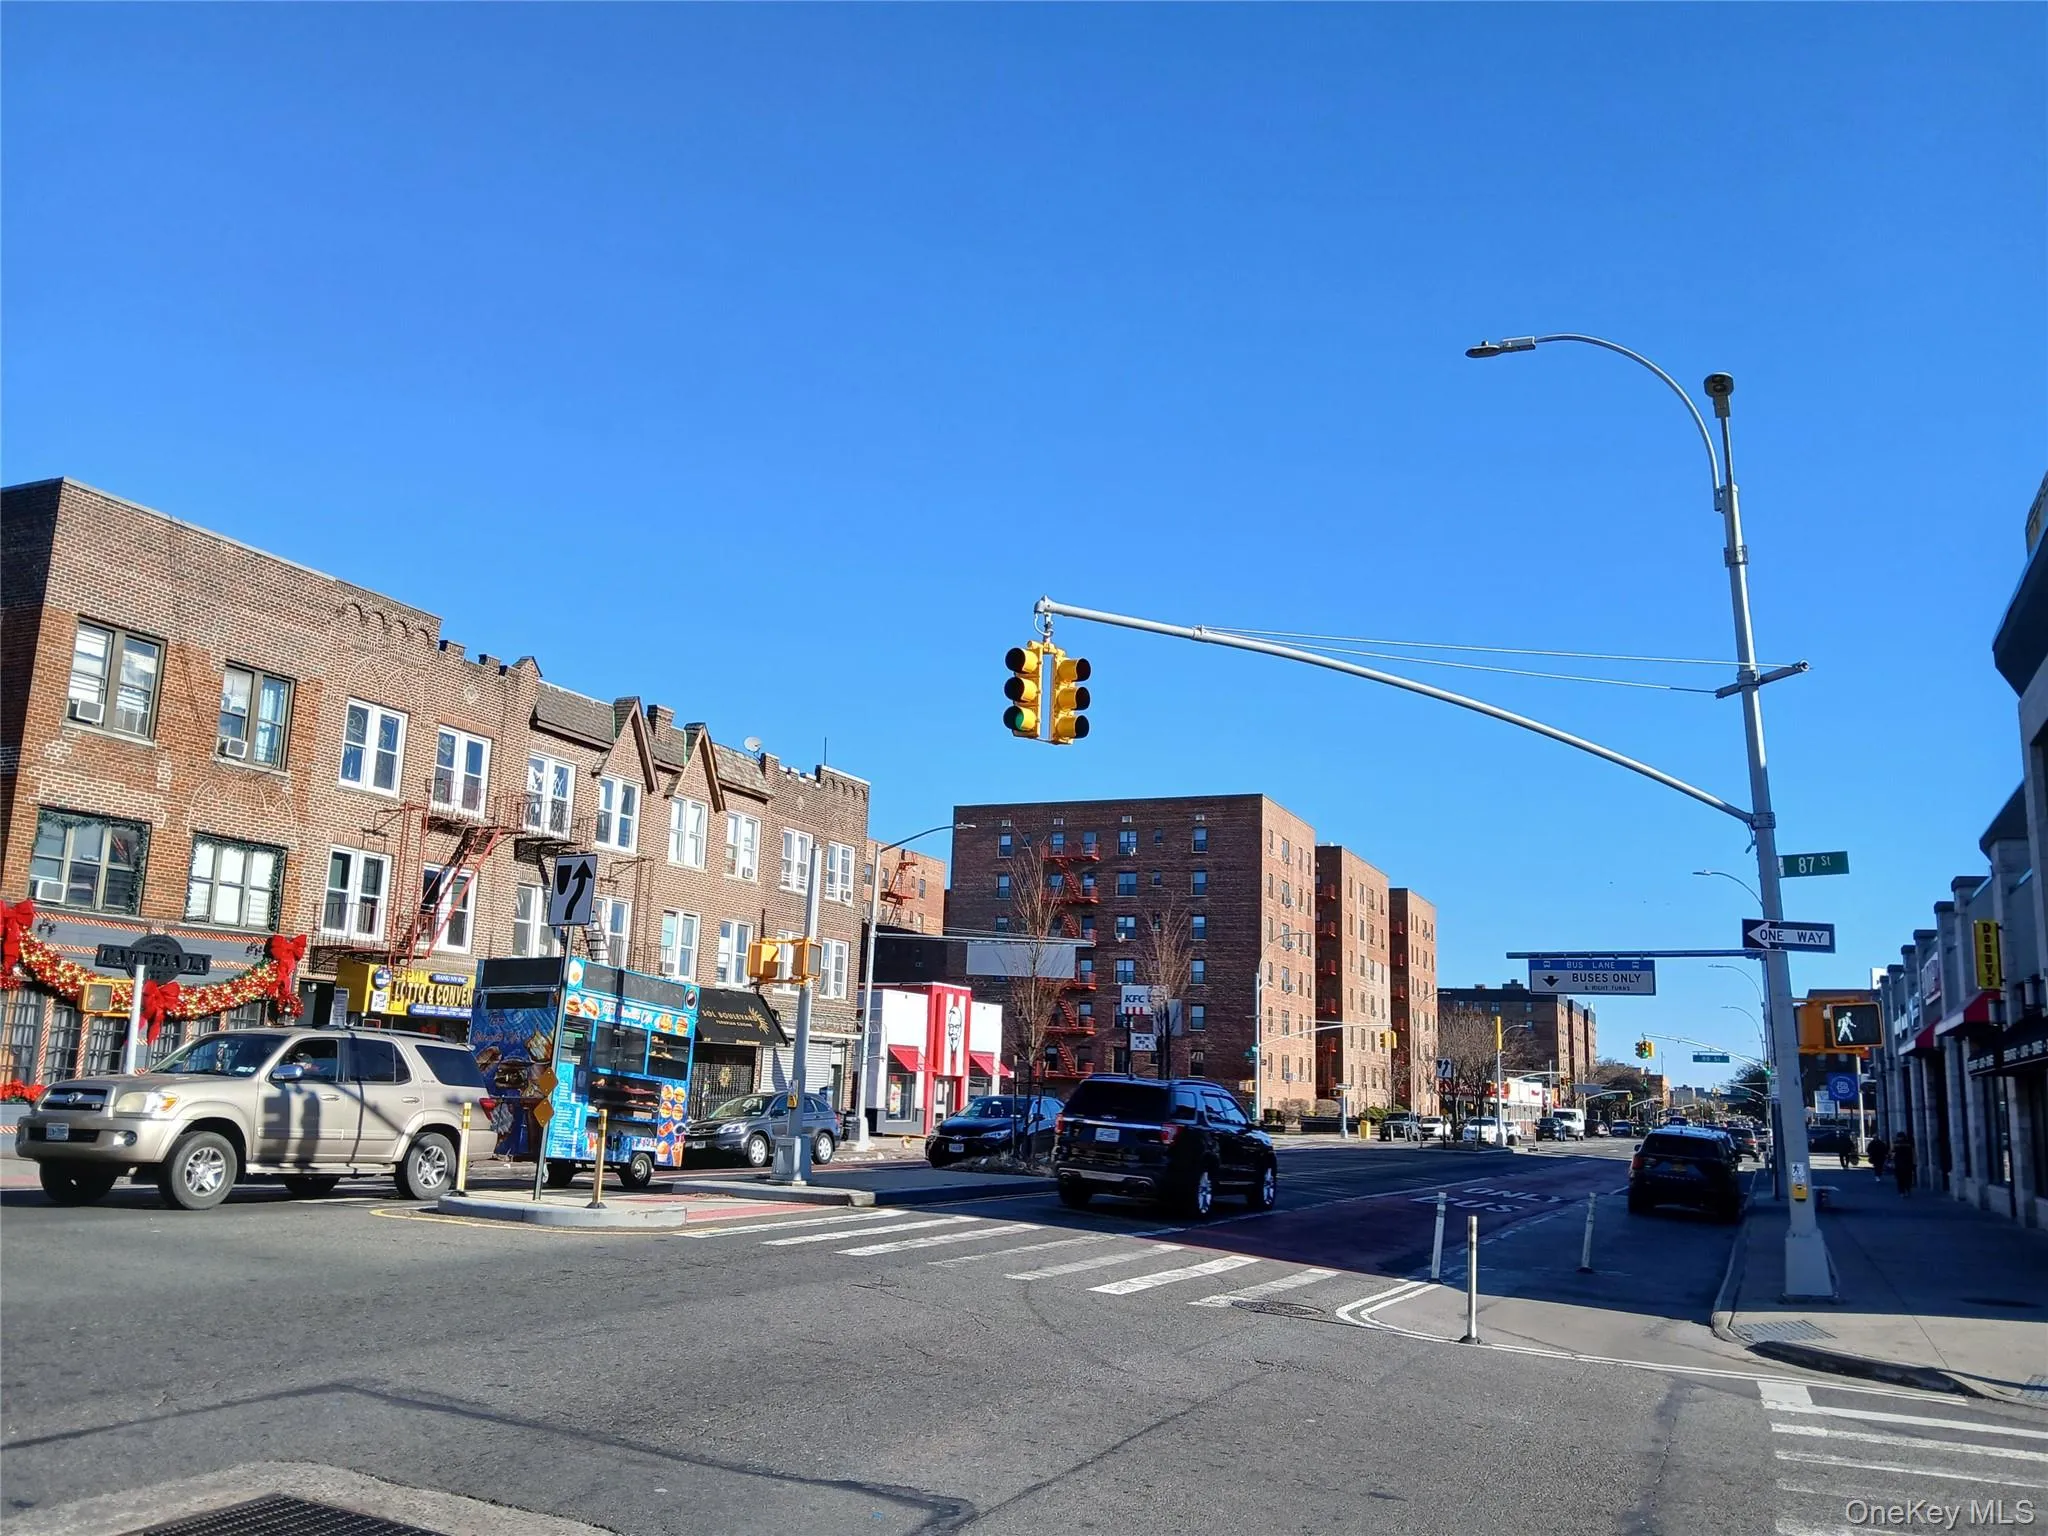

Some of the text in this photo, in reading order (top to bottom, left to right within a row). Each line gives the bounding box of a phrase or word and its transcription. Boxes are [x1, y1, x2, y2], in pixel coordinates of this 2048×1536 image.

[1798, 855, 1832, 874] 87 St
[1760, 929, 1825, 943] ONE WAY
[1566, 961, 1616, 969] BUS LANE
[1572, 973, 1641, 983] BUSES ONLY
[394, 982, 426, 1004] LOTTO
[1124, 995, 1145, 1003] KFC
[701, 1010, 717, 1018] SOL
